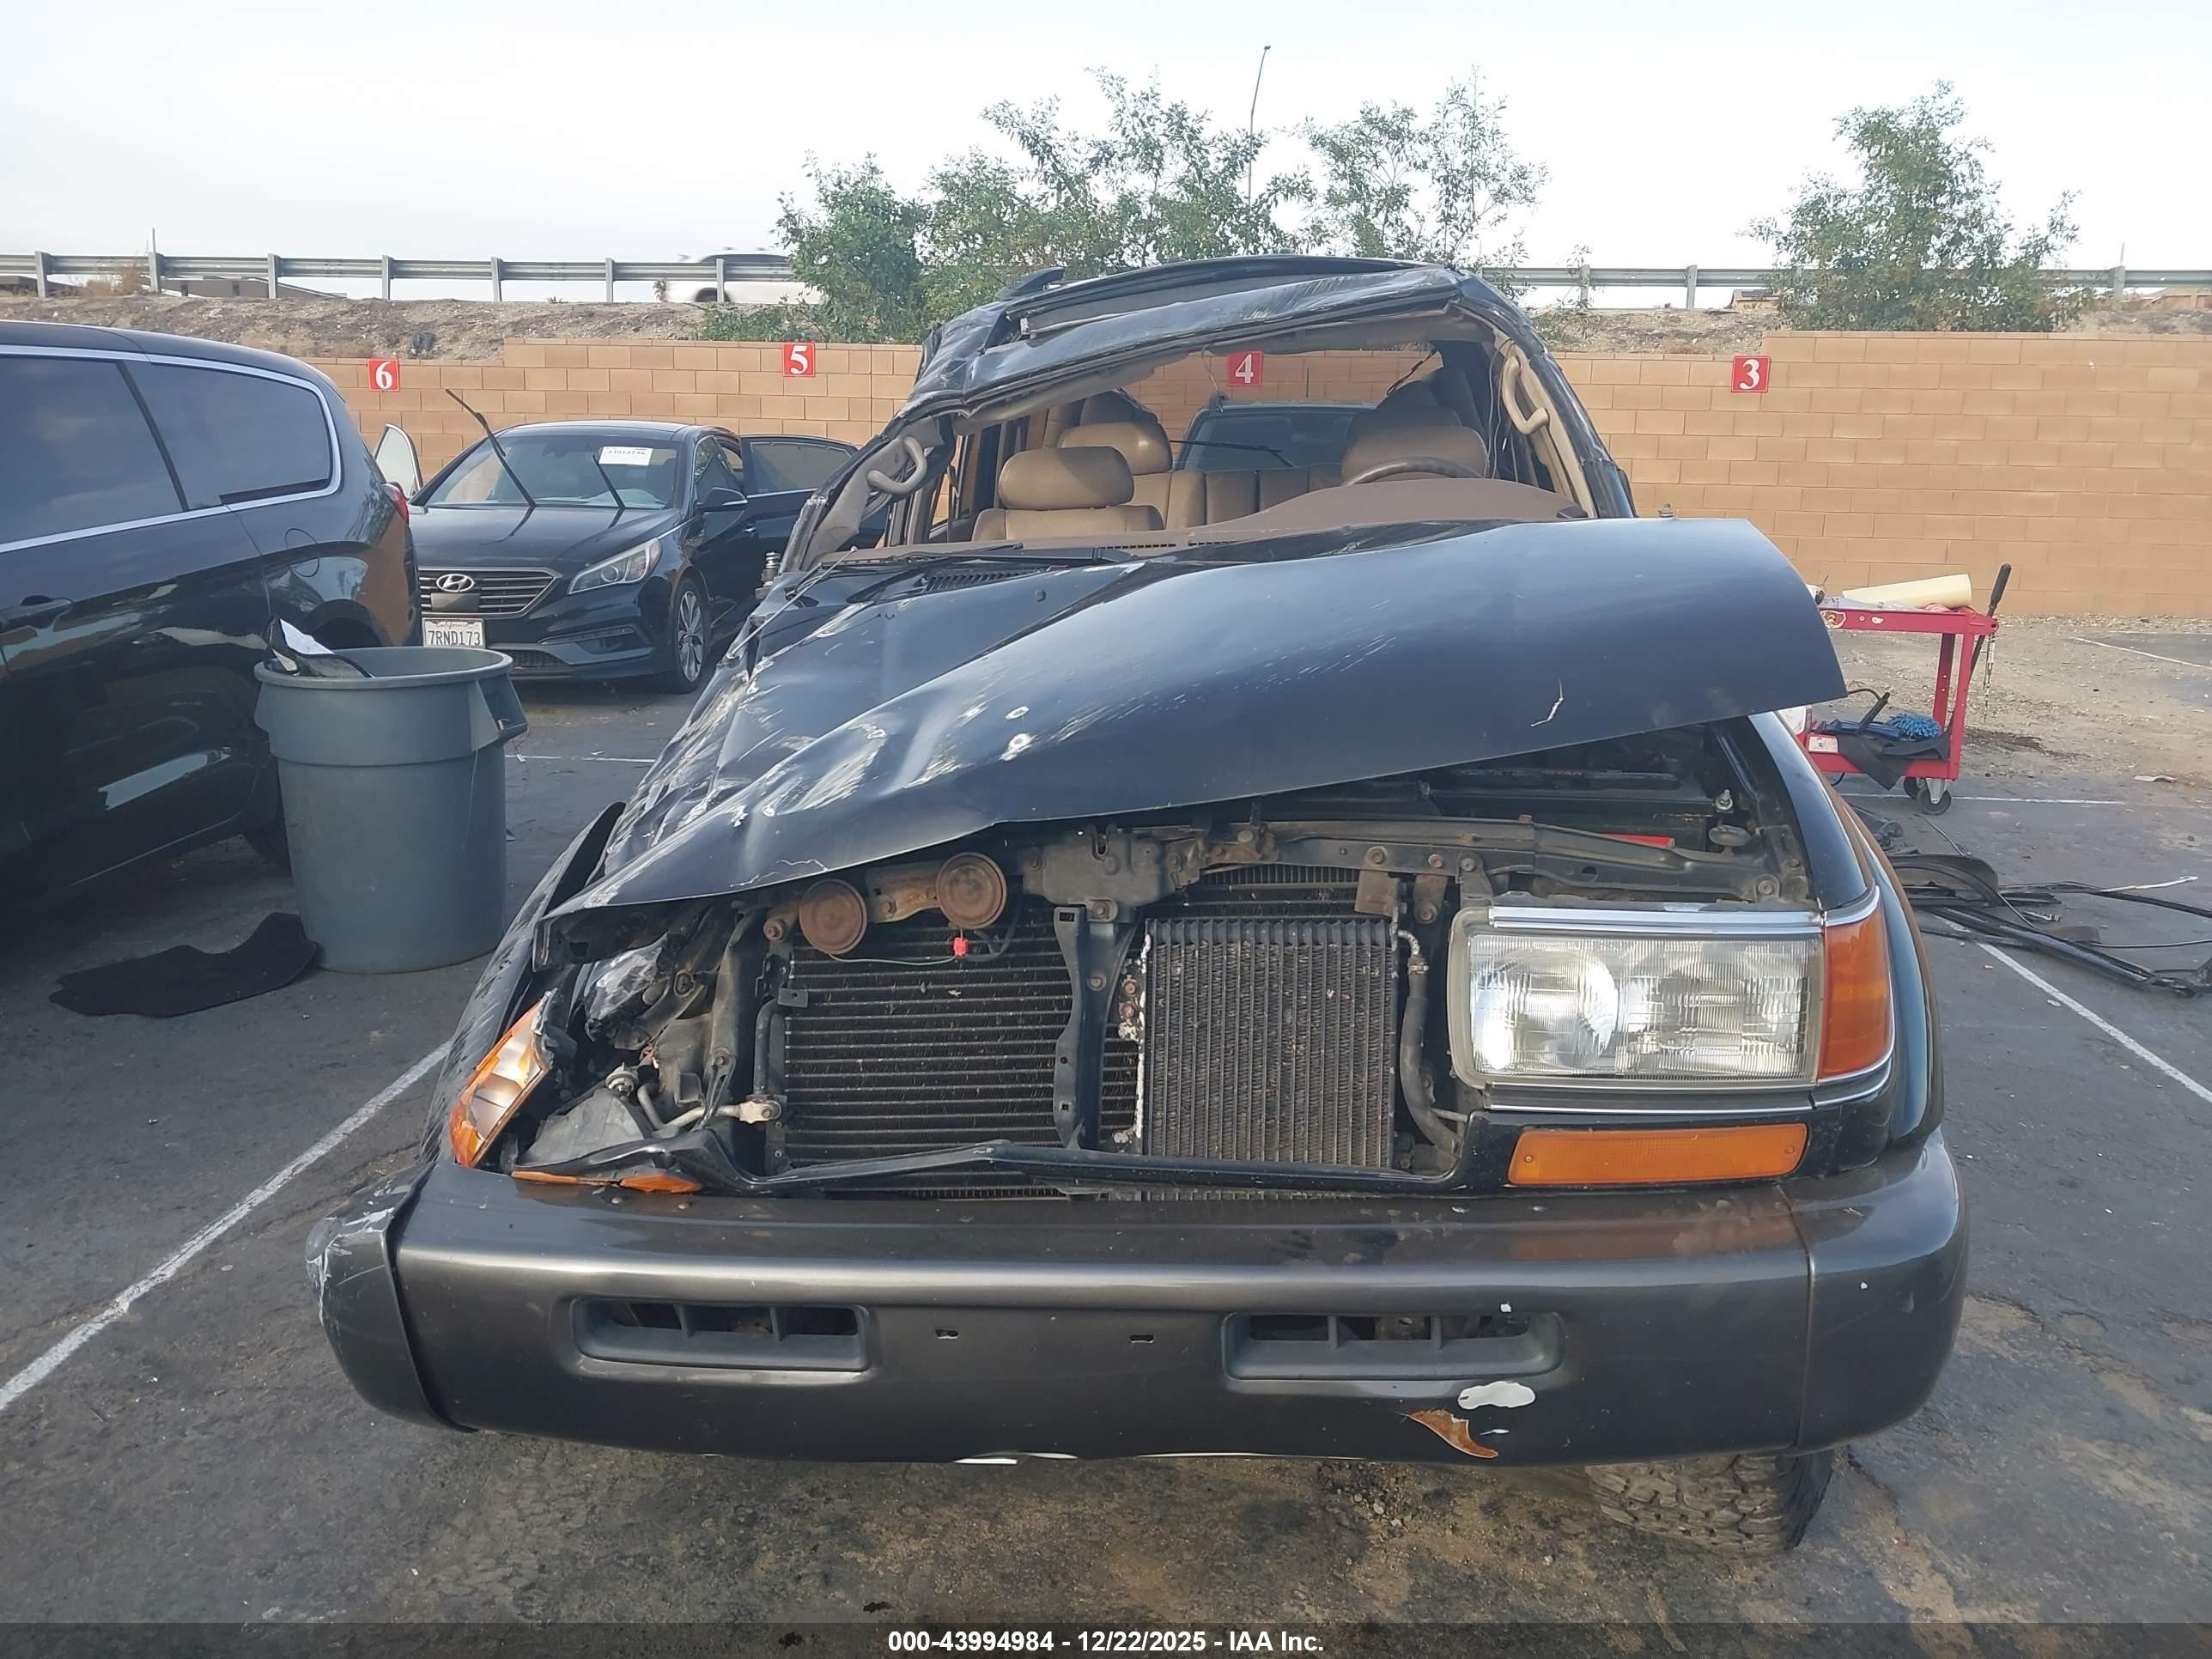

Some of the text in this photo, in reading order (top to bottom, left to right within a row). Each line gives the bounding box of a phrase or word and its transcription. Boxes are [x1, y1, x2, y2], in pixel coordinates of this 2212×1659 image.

[789, 345, 809, 375] 5
[1234, 354, 1254, 385] 4
[1740, 358, 1761, 391] 3
[374, 362, 393, 390] 6
[428, 630, 481, 647] 7RND173
